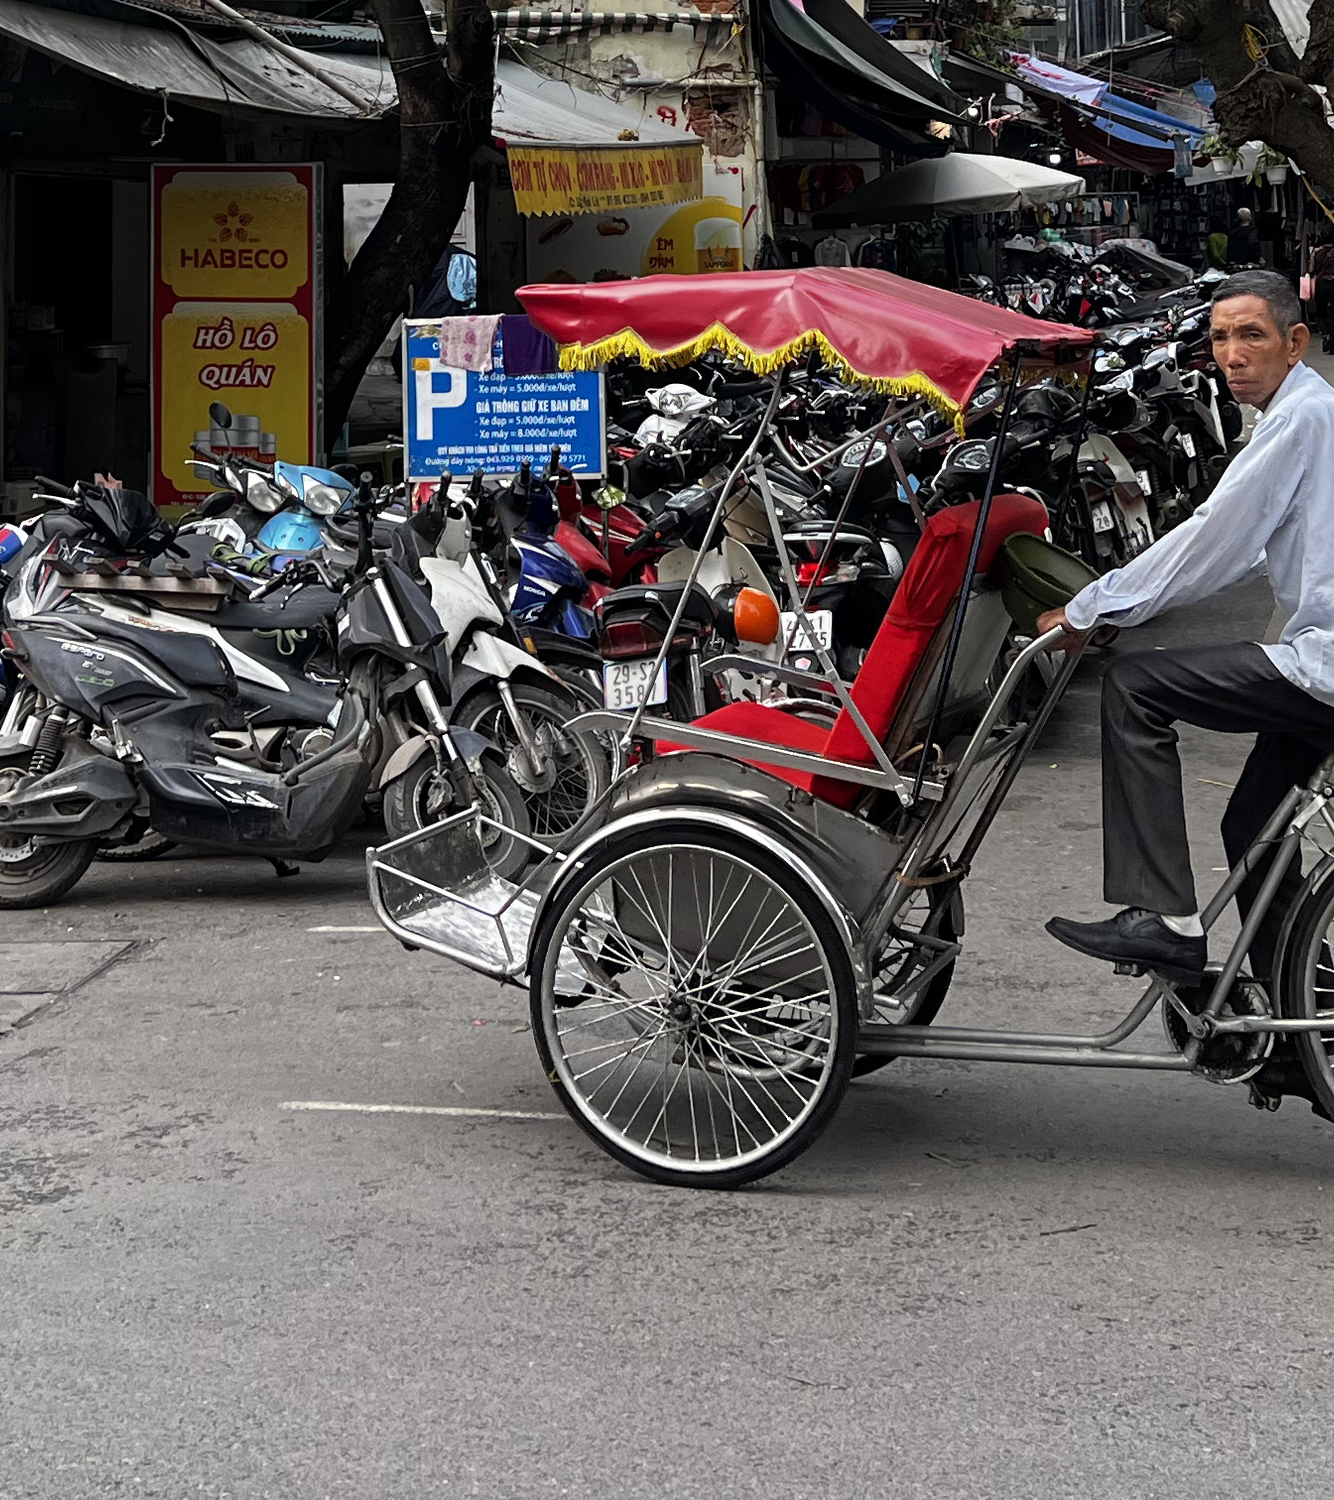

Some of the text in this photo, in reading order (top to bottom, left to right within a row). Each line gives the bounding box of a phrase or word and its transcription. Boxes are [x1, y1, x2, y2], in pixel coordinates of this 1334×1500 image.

[180, 248, 288, 269] HABECO
[193, 317, 278, 351] HỒ LÔ
[199, 358, 276, 390] QUÁN
[413, 357, 468, 441] P
[537, 400, 549, 412] XE
[550, 399, 569, 412] BAN
